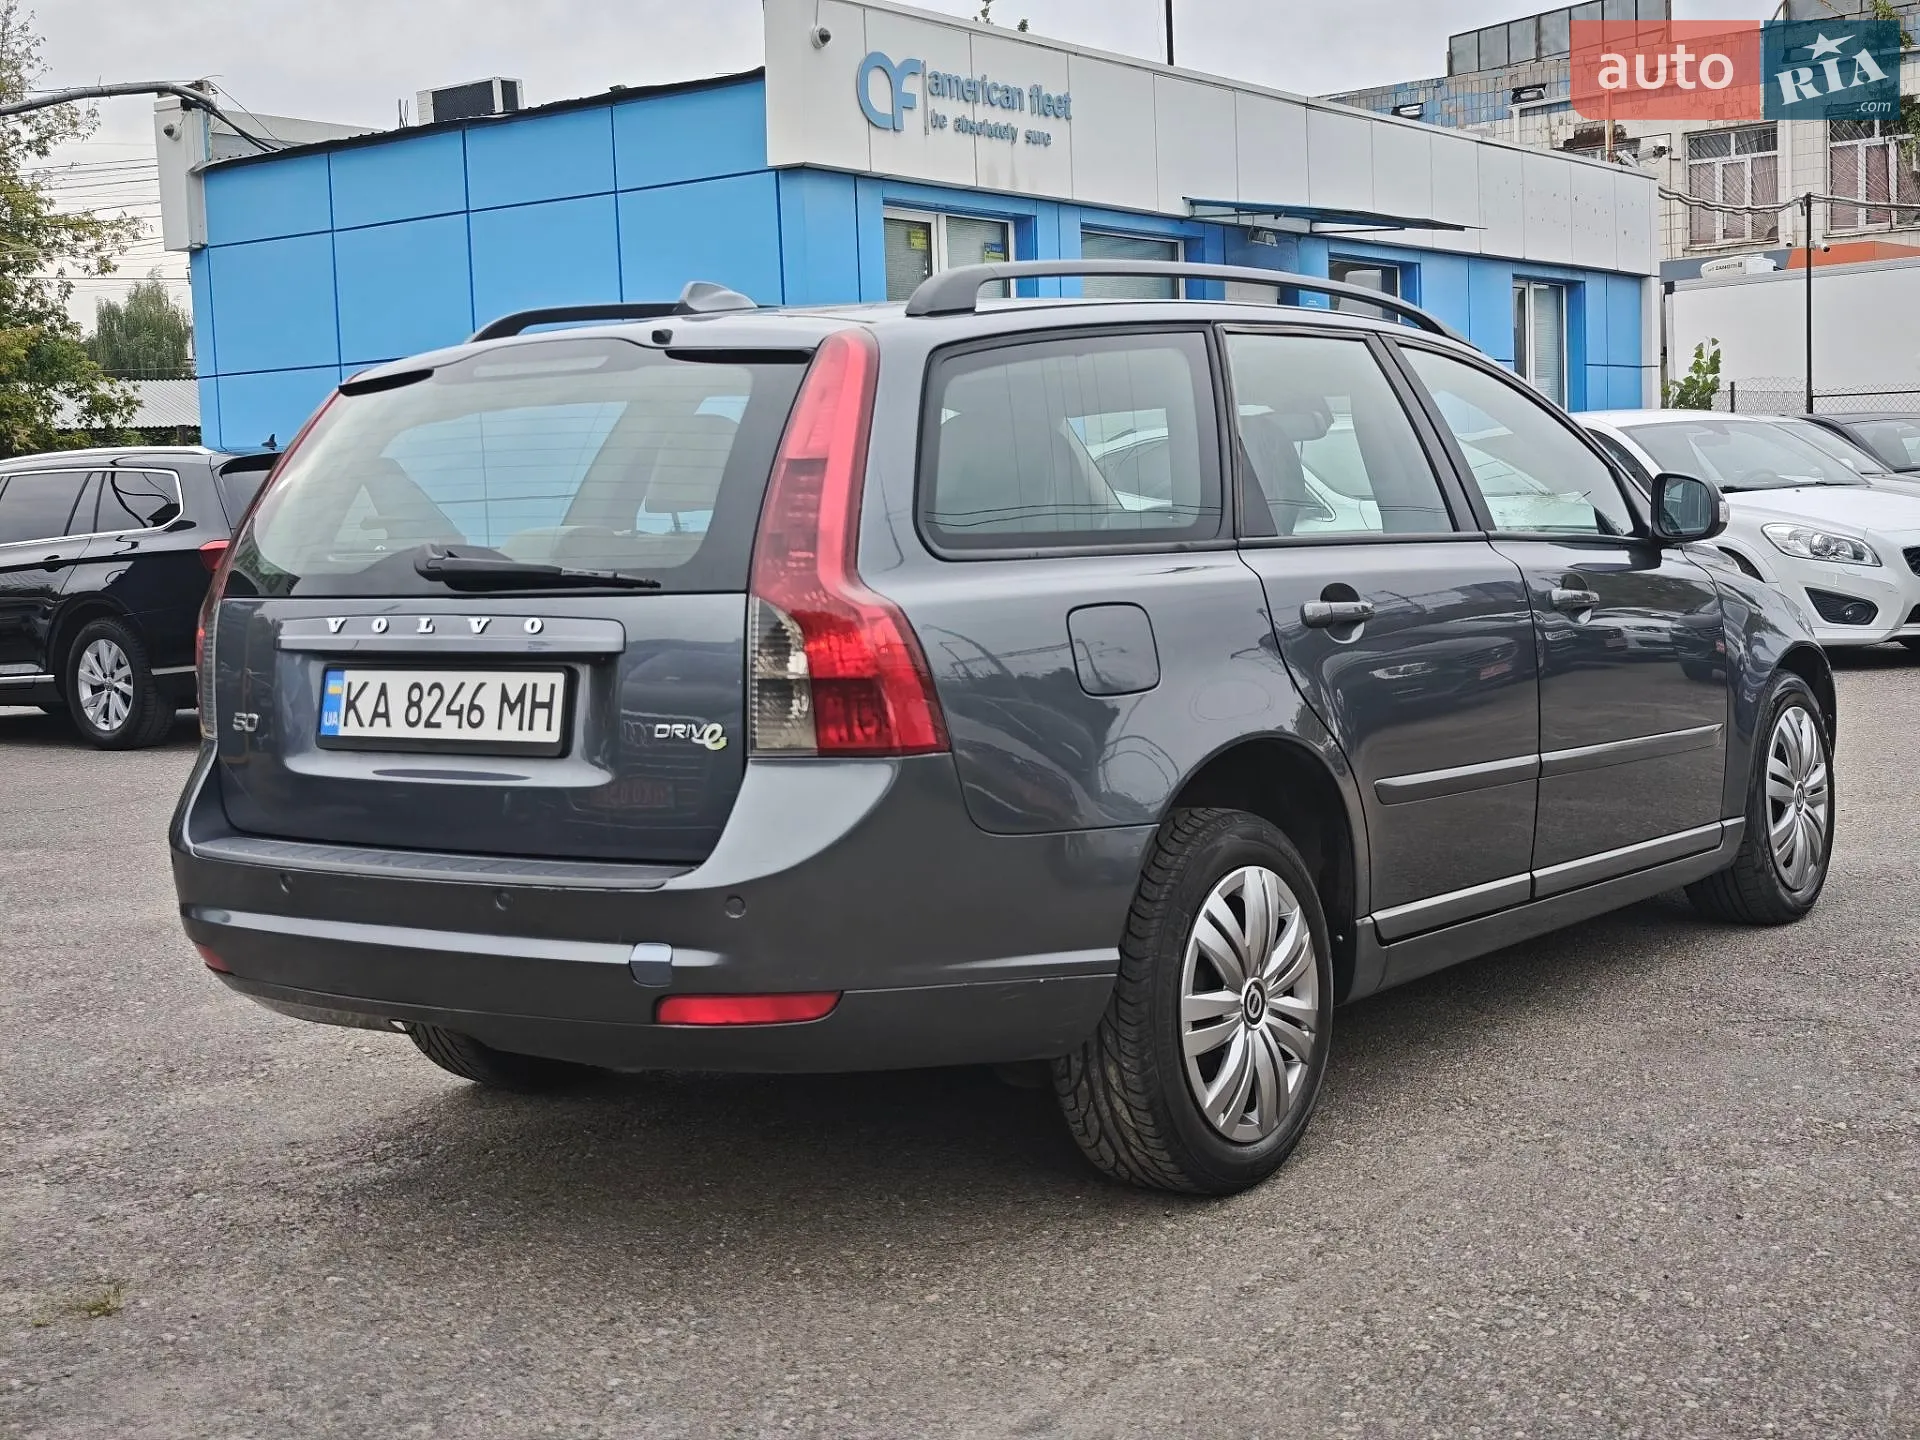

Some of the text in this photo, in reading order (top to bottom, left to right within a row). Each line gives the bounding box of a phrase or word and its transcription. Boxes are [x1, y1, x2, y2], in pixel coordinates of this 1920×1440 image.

[927, 70, 1073, 121] american fleet
[953, 114, 1019, 145] absolutely
[1024, 128, 1053, 147] sure
[326, 616, 545, 635] VOLVO
[323, 711, 339, 727] UA
[343, 680, 556, 732] KA 8246 MH
